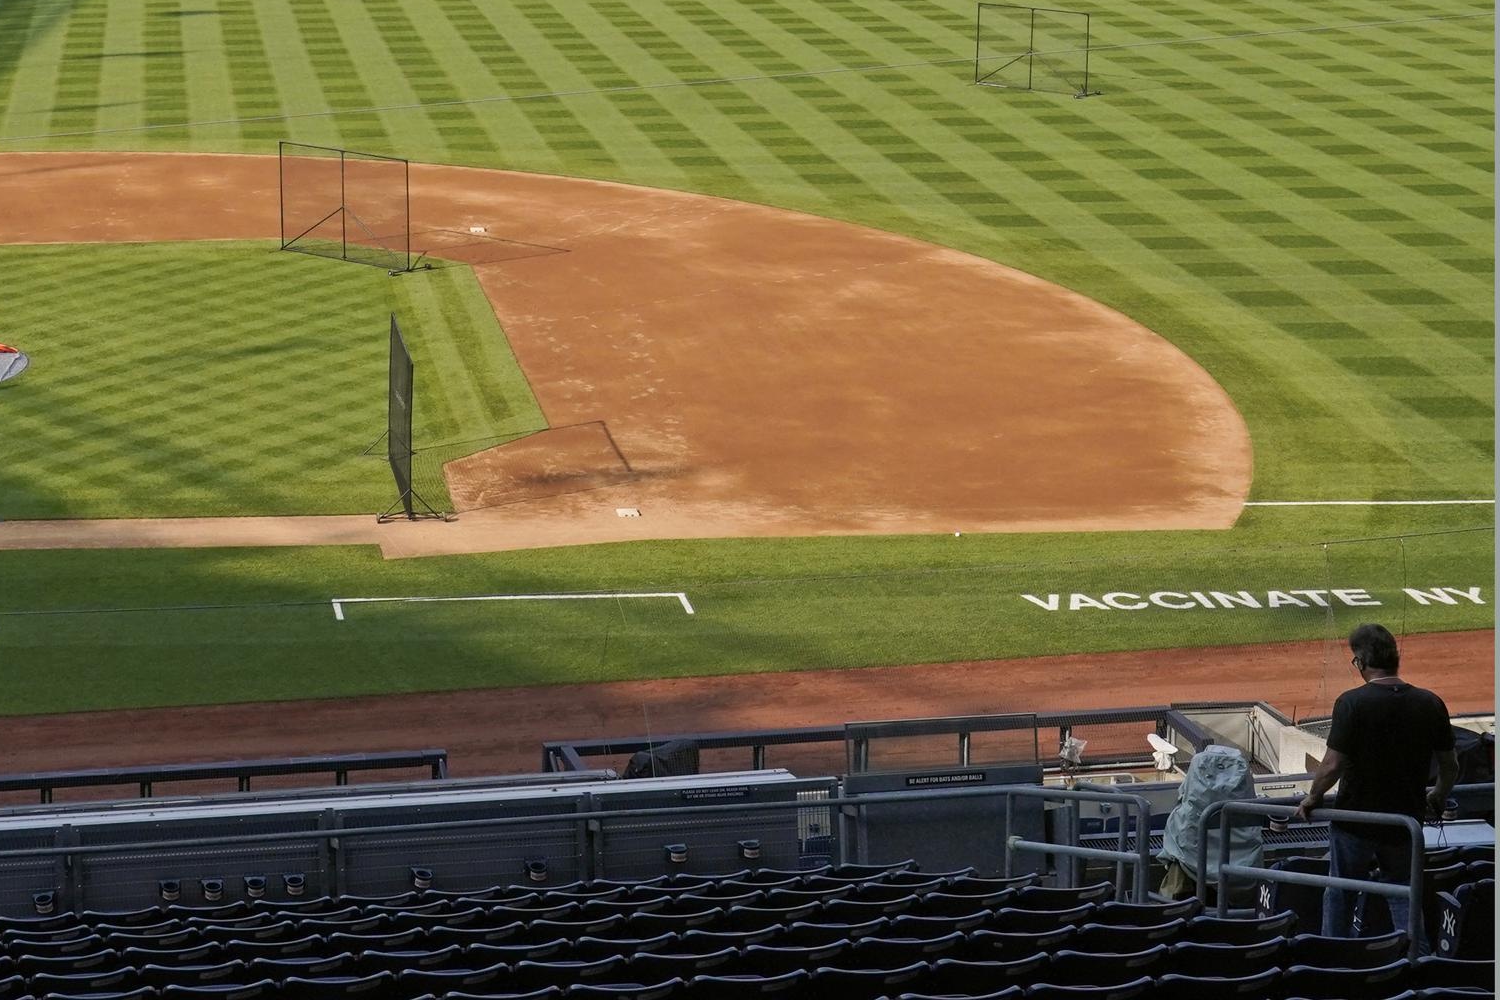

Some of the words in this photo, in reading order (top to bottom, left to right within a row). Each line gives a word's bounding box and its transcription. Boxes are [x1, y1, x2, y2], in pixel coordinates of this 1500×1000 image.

[1021, 588, 1383, 611] VACCINATE
[1402, 586, 1487, 605] NY
[1442, 909, 1456, 937] NY
